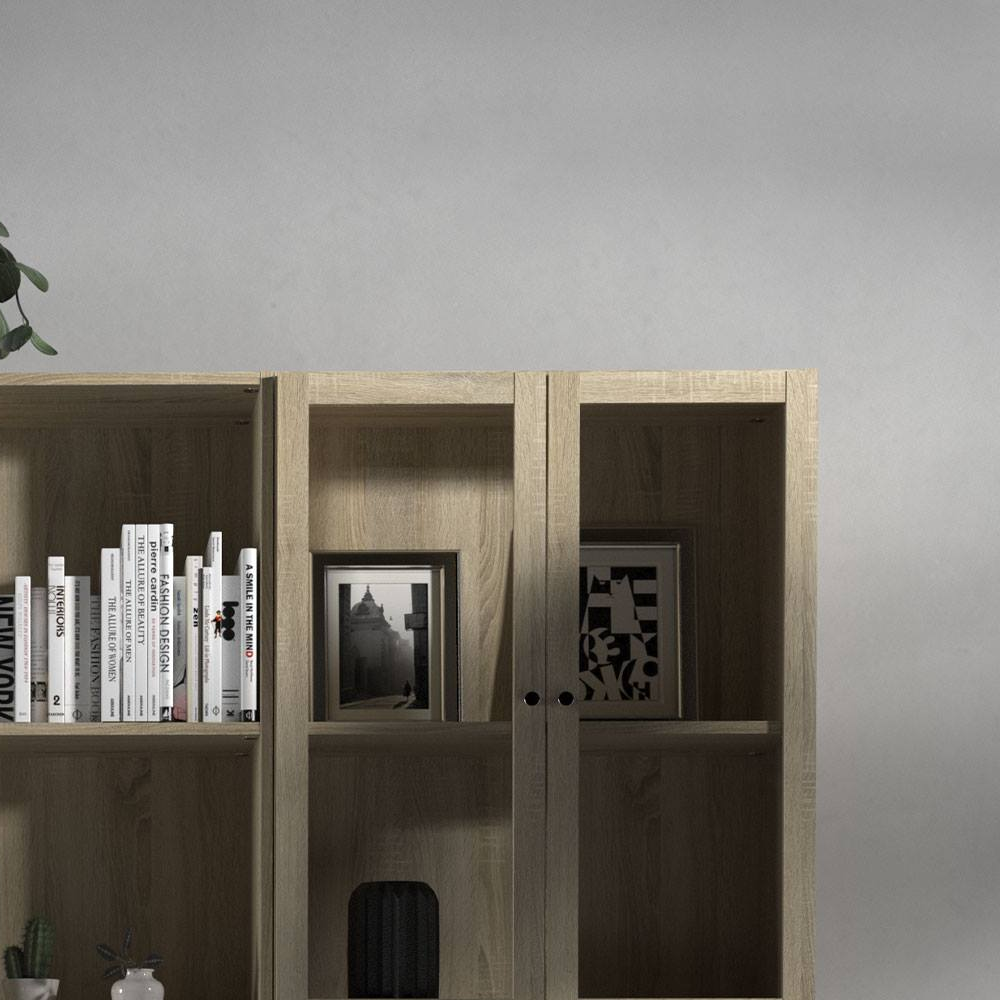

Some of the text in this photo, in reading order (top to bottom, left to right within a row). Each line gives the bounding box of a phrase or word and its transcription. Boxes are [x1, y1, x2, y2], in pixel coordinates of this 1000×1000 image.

[137, 536, 145, 645] THE ALLURE OF BEAUTY
[149, 541, 158, 612] pierre cardin
[245, 573, 254, 600] SMILE
[56, 585, 64, 638] INTERIORS
[160, 574, 170, 626] FASHION
[245, 602, 254, 612] IN
[108, 597, 117, 682] THE ALLURE OF WOMEN
[125, 631, 132, 642] OF
[245, 614, 254, 631] THE
[90, 627, 101, 684] FASHION
[160, 629, 170, 673] DESIGN
[245, 633, 254, 658] MIND
[53, 695, 61, 706] 2
